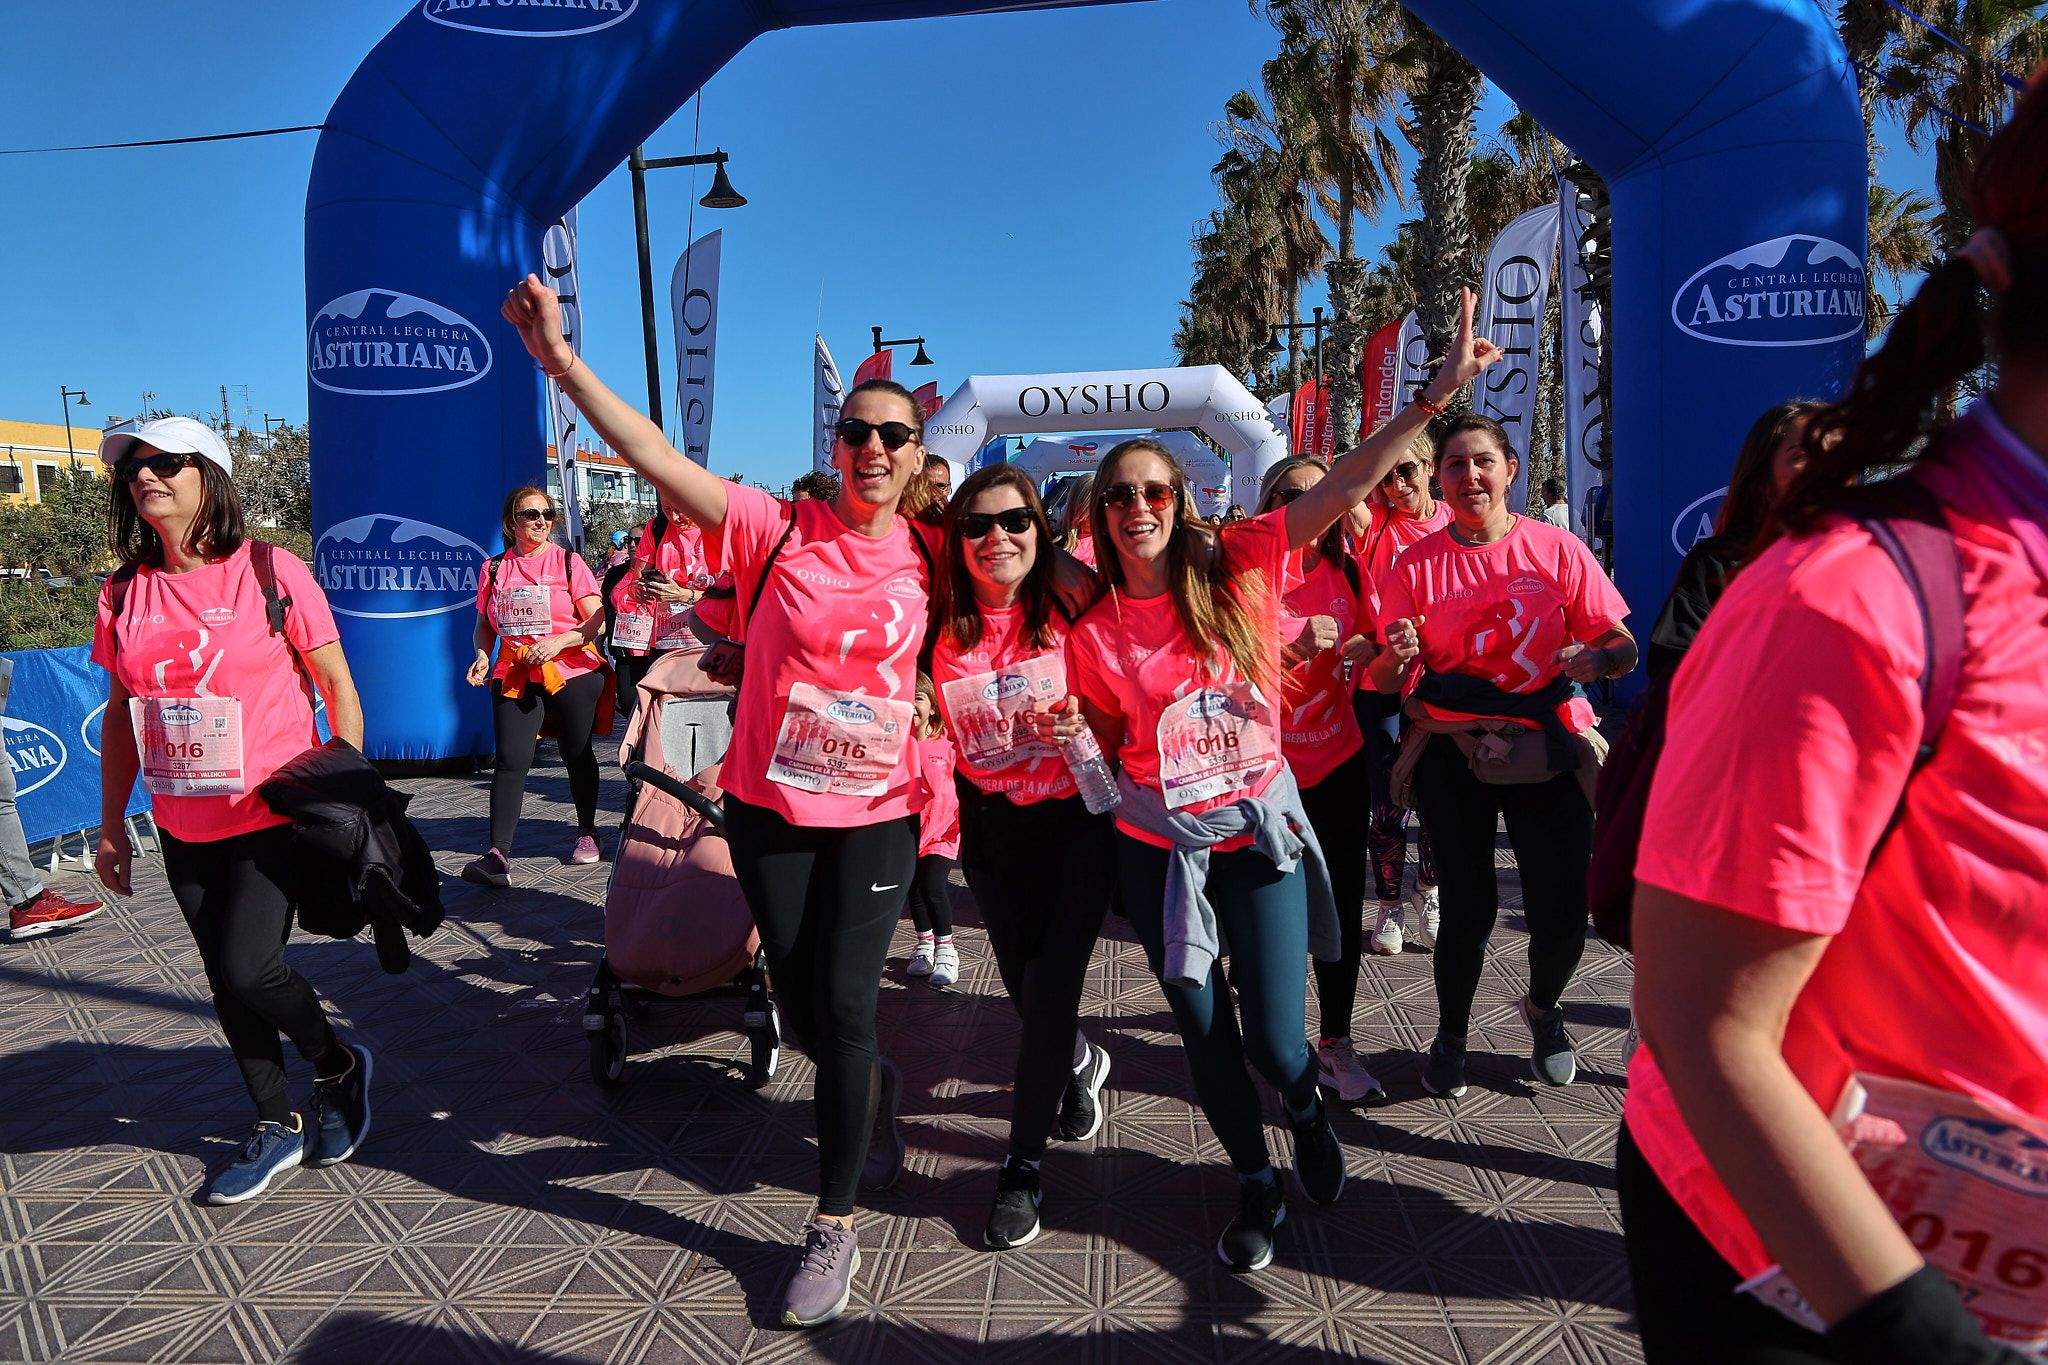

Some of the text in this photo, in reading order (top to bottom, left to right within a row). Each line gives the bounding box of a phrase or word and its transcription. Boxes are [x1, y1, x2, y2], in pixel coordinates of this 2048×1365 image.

[1728, 272, 1862, 289] CENTRAL LECHERA
[1688, 283, 1863, 326] ASTURIANA
[326, 325, 469, 341] CENTRAL LECHERA
[312, 331, 477, 373] ASTURIANA
[1018, 381, 1170, 417] OYSHO
[1215, 411, 1261, 423] OYSHO
[930, 425, 975, 435] OYSHO
[1241, 475, 1265, 487] OYS
[332, 550, 473, 561] CENTRAL LECHERA
[318, 552, 478, 592] ASTURIANA
[796, 569, 850, 589] OYSHO
[512, 607, 533, 616] 016
[831, 705, 872, 721] ASTURIANA
[997, 709, 1035, 733] 016
[6, 733, 40, 745] HERA
[1196, 731, 1239, 755] 016
[165, 742, 204, 758] 016
[822, 738, 867, 759] 016
[172, 762, 190, 770] 3287
[826, 758, 848, 770] 5392
[981, 752, 1016, 768] OYSHO
[200, 770, 227, 778] VALENCIA
[783, 769, 821, 786] OYSHO
[151, 780, 229, 791] OYSHO Santander
[1179, 782, 1213, 799] OYSHO
[1935, 1124, 2048, 1185] ASTURIA
[1901, 1212, 2048, 1290] 016
